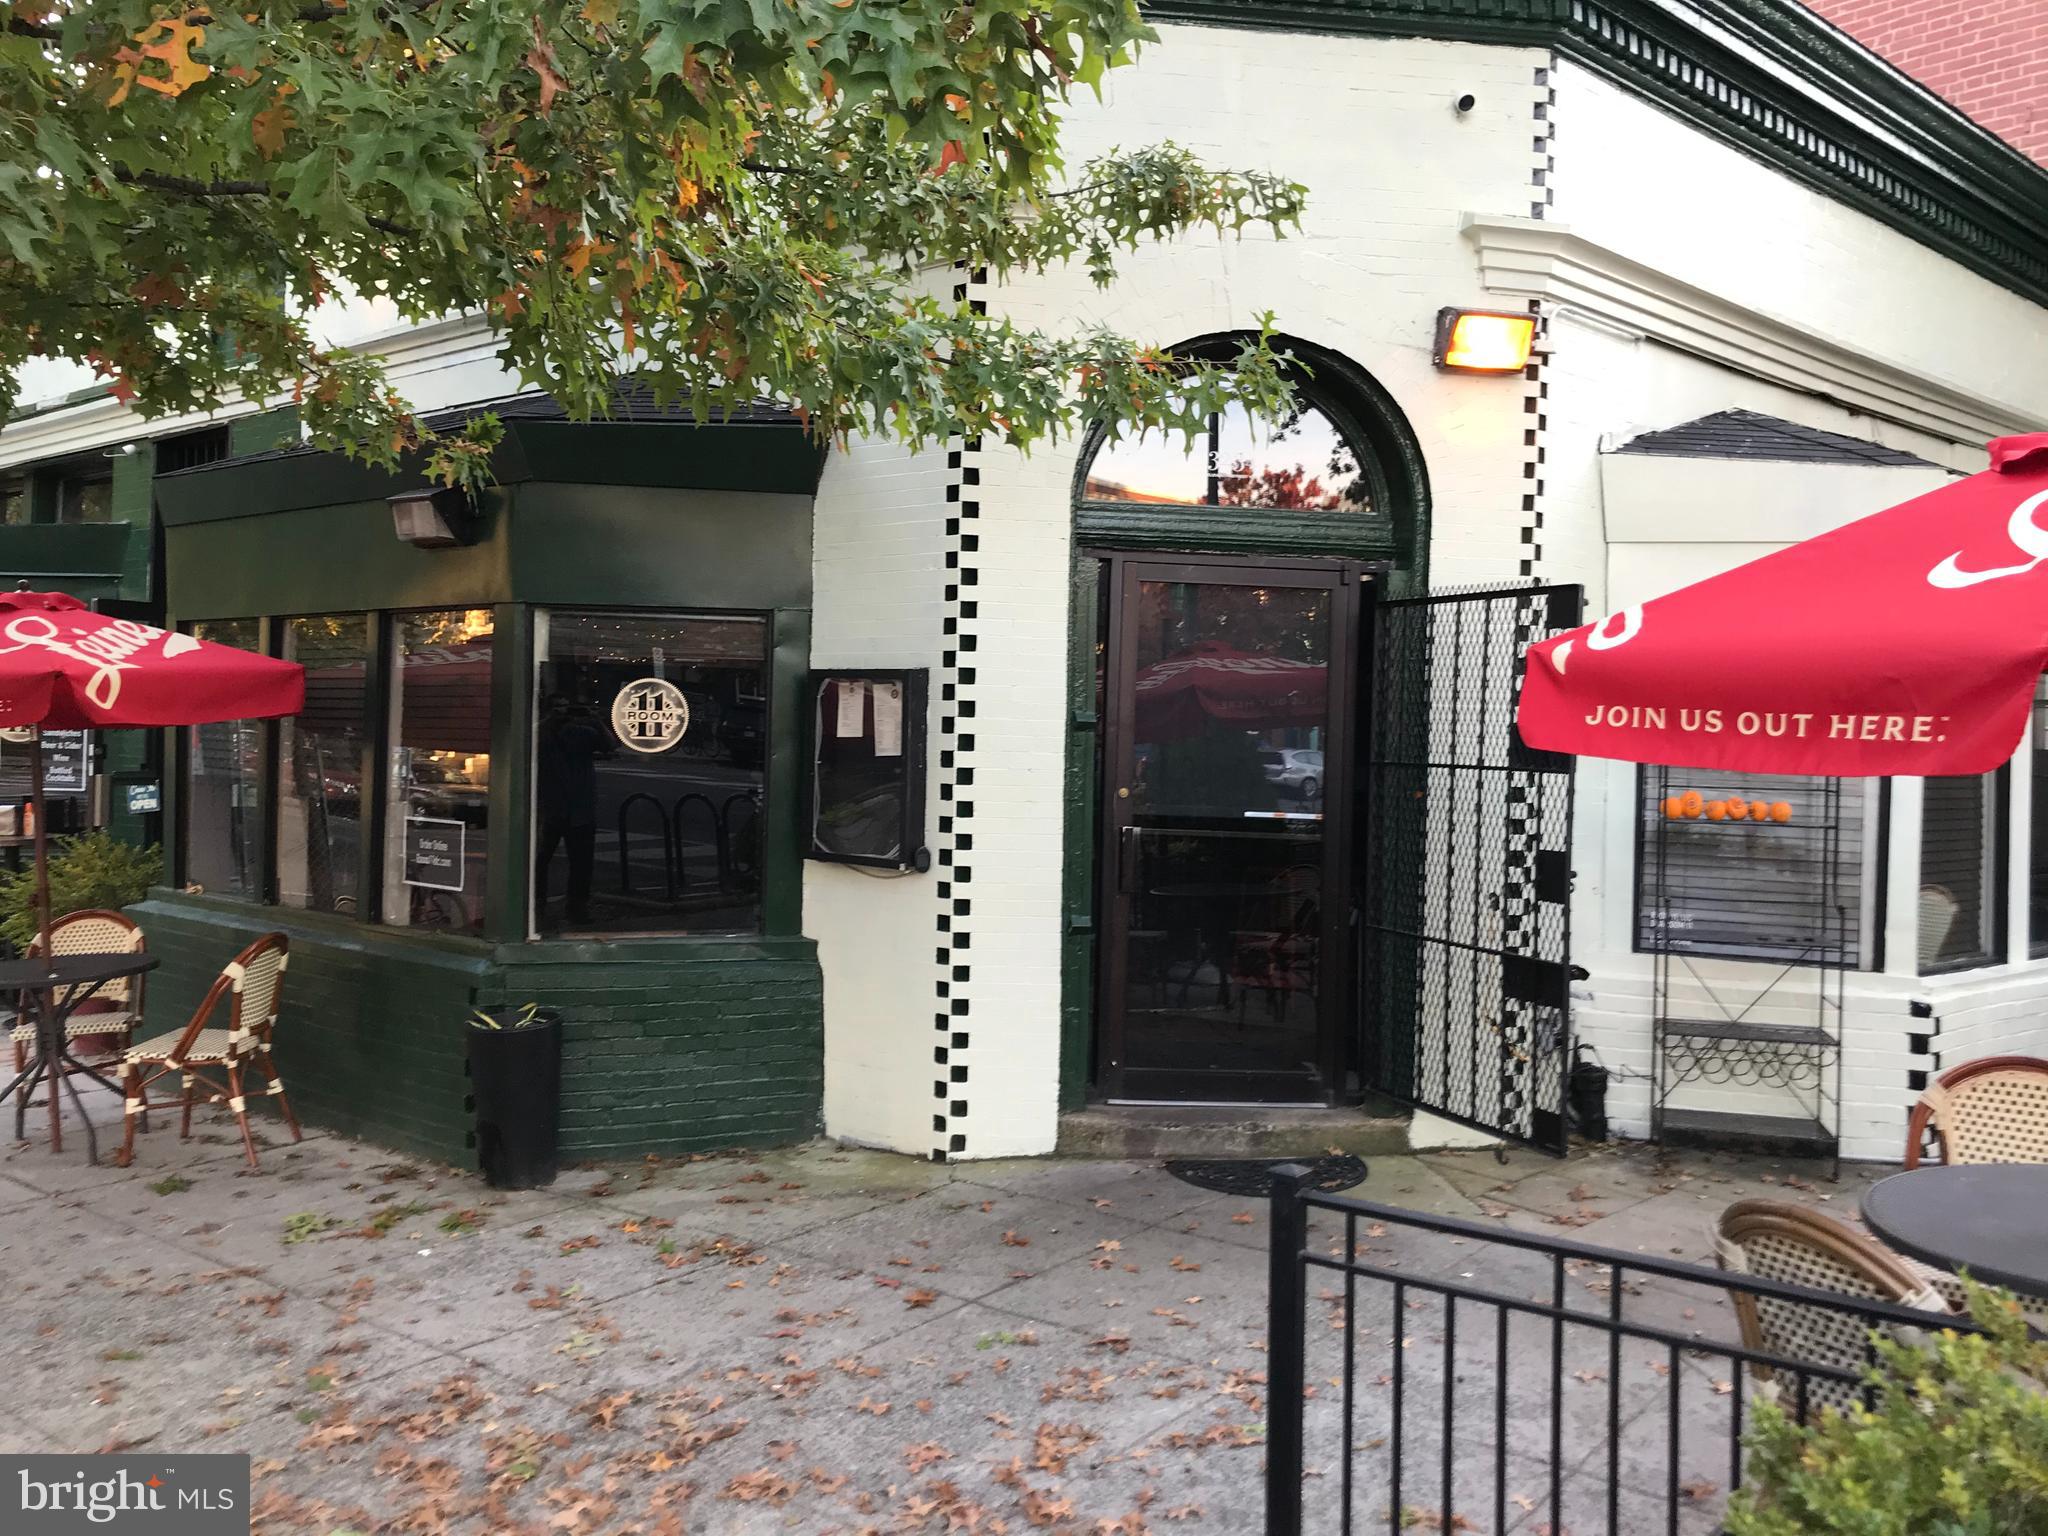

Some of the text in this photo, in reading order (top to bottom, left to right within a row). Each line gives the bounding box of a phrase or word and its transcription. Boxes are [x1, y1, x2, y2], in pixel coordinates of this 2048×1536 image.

[627, 711, 674, 721] ROOM
[1584, 705, 1667, 730] JOIN
[1679, 709, 1725, 733] US
[1736, 711, 1814, 738] OUT
[130, 799, 158, 810] OPEN
